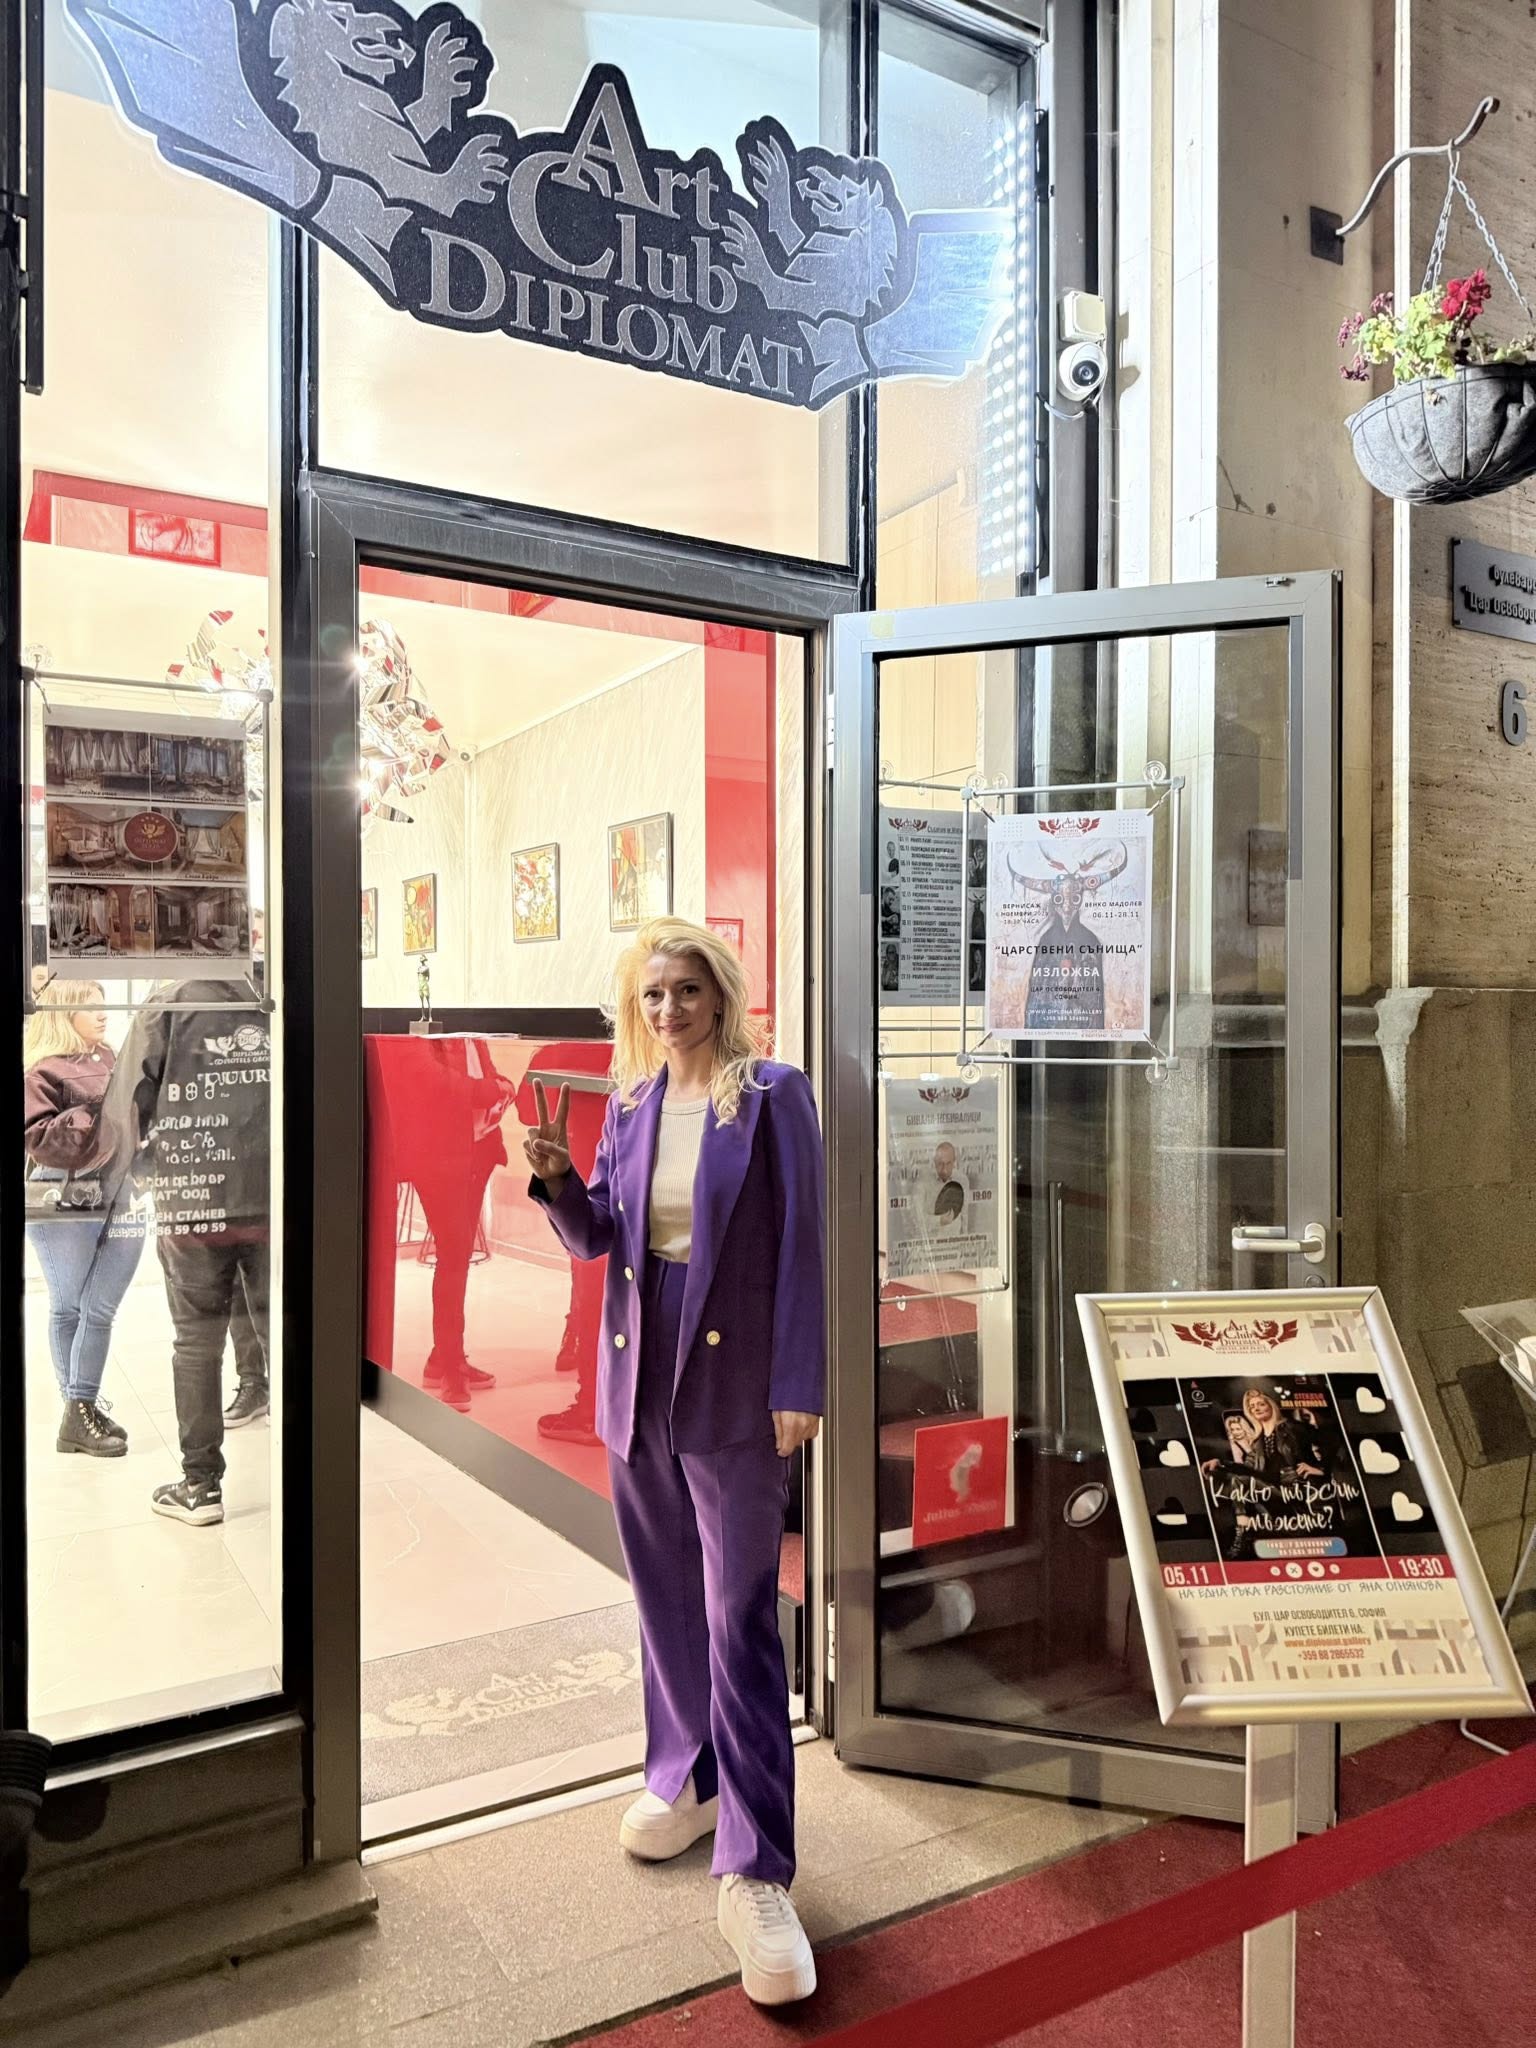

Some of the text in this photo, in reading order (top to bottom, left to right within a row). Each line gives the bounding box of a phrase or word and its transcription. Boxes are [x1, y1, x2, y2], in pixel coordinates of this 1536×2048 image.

[551, 82, 720, 231] Art
[508, 151, 738, 315] Club
[420, 228, 802, 397] DIPLOMAT
[1502, 680, 1528, 747] 6
[1032, 967, 1100, 977] ИЗЛОЖБА
[890, 1198, 907, 1208] 13.11
[972, 1191, 992, 1201] 19:00
[176, 1208, 226, 1221] СТАНЕВ
[1163, 1565, 1209, 1585] 05.11
[1398, 1557, 1445, 1577] 19:30
[1179, 1589, 1195, 1600] НА
[1199, 1588, 1228, 1599] ЕДНА
[1231, 1586, 1261, 1597] РЪКА
[1264, 1582, 1334, 1595] РАЗСТОЯНИЕ
[1338, 1582, 1352, 1593] ОТ
[1359, 1582, 1382, 1592] ЯНА
[1273, 1610, 1290, 1621] ЦАР
[1292, 1608, 1348, 1620] ОСВОБОДИТЕЛ
[1358, 1607, 1386, 1617] СОФИЯ
[1284, 1624, 1315, 1636] КУПЕТЕ
[1316, 1624, 1349, 1635] БИЛЕТИ
